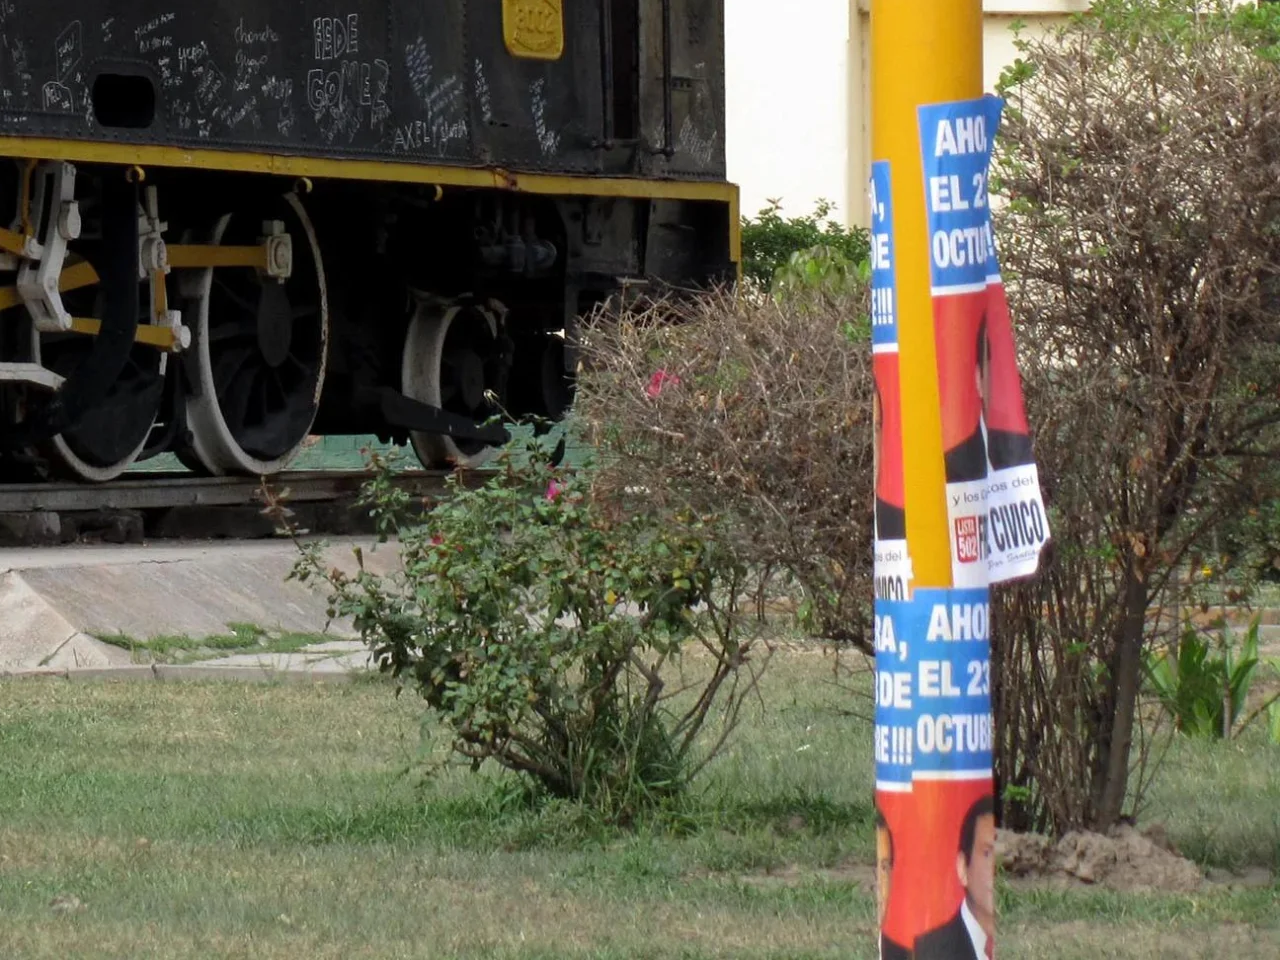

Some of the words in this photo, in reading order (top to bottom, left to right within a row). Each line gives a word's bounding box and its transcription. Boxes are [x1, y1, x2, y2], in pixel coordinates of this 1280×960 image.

[934, 116, 987, 157] AHO
[930, 175, 969, 212] EL
[973, 169, 987, 208] 2
[953, 495, 960, 507] y
[957, 519, 976, 535] LISTA
[990, 498, 1044, 552] CIVICO
[958, 536, 977, 558] 502
[926, 603, 990, 642] AHO
[918, 660, 960, 697] EL
